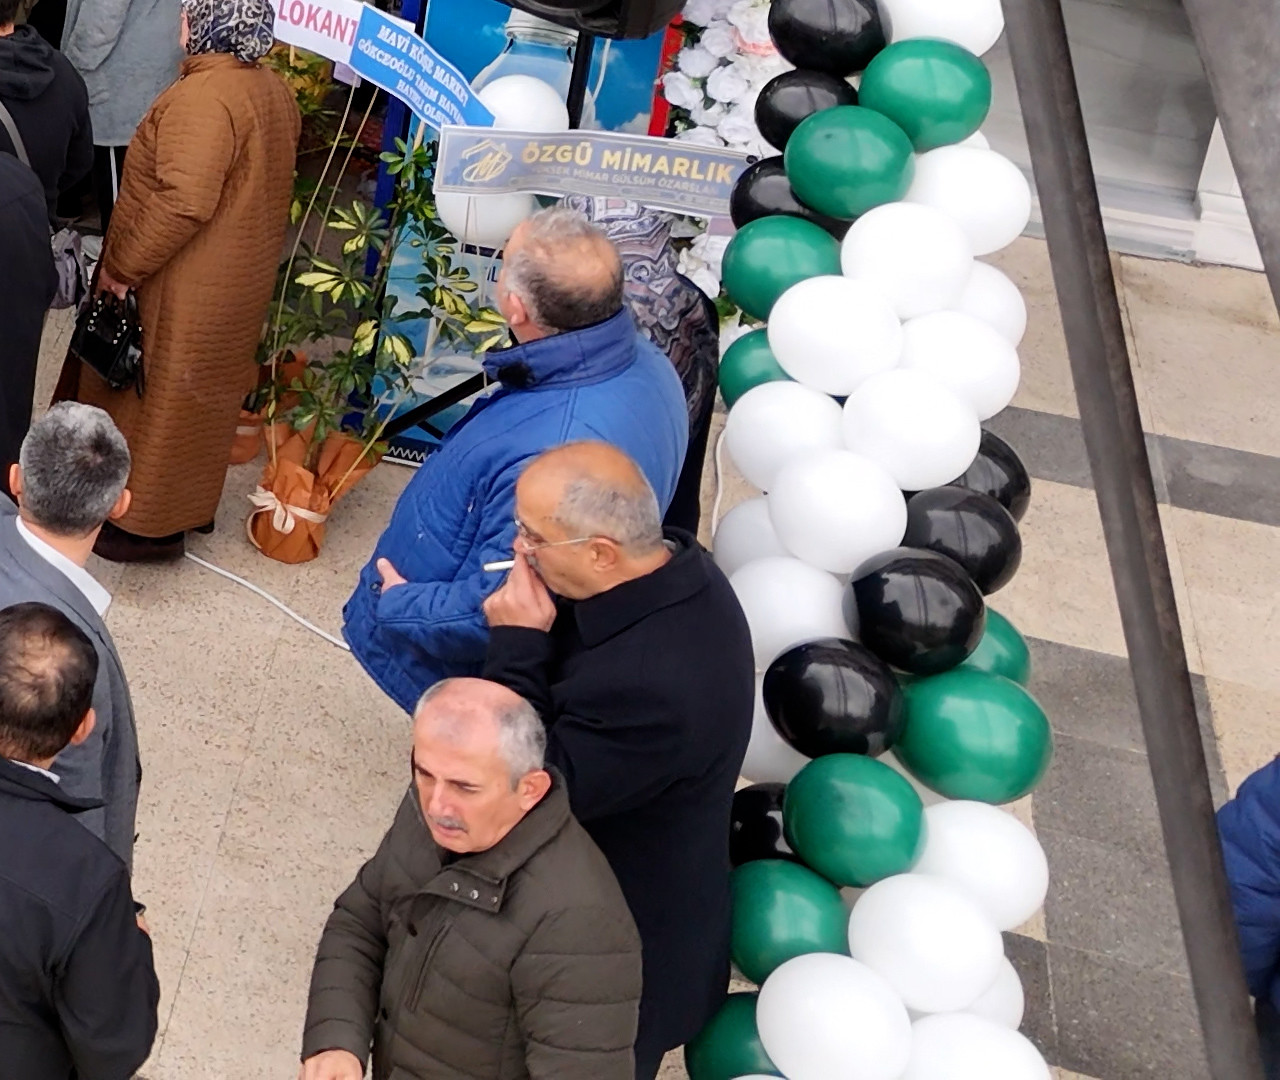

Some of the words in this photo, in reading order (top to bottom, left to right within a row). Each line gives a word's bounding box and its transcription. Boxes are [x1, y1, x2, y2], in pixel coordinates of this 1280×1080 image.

[376, 24, 411, 53] MAVİ
[521, 141, 593, 166] ÖZGÜ
[600, 147, 736, 185] MİMARLIK
